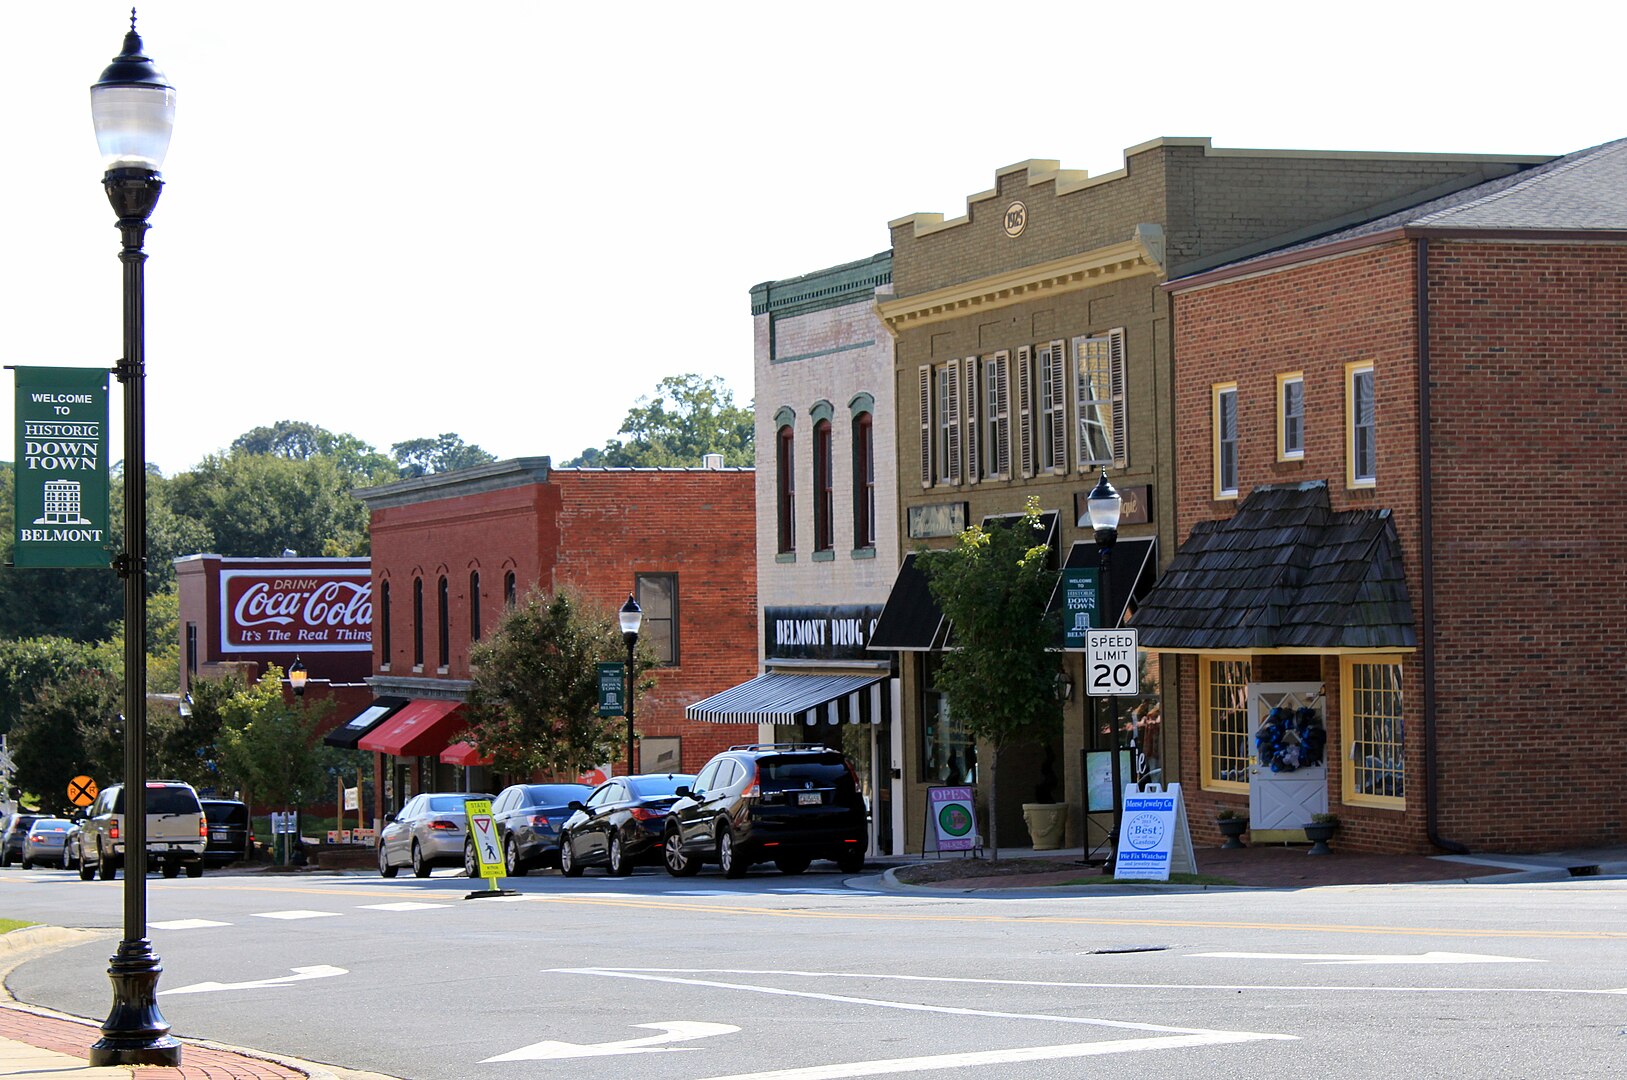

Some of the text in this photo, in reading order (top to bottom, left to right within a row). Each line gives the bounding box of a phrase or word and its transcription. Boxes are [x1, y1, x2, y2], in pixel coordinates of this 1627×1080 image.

[1007, 209, 1023, 228] 1925
[31, 393, 92, 404] WELCOME
[53, 406, 70, 415] TO
[25, 424, 99, 436] HISTORIC
[25, 441, 98, 456] DOWN
[25, 456, 98, 470] TOWN
[20, 529, 103, 542] BELMONT
[273, 579, 318, 590] DRINK
[234, 581, 372, 627] Coca-Cola
[241, 629, 372, 641] It's The Real Thing
[776, 619, 827, 645] BELMONT
[831, 618, 863, 645] DRUG
[1091, 637, 1133, 648] SPEED
[1095, 650, 1128, 661] LIMIT
[1093, 663, 1132, 687] 20
[70, 786, 96, 796] R R
[931, 788, 971, 800] OPEN
[1143, 799, 1164, 809] Jewelry
[1163, 799, 1173, 808] Co.
[1135, 826, 1157, 834] Best
